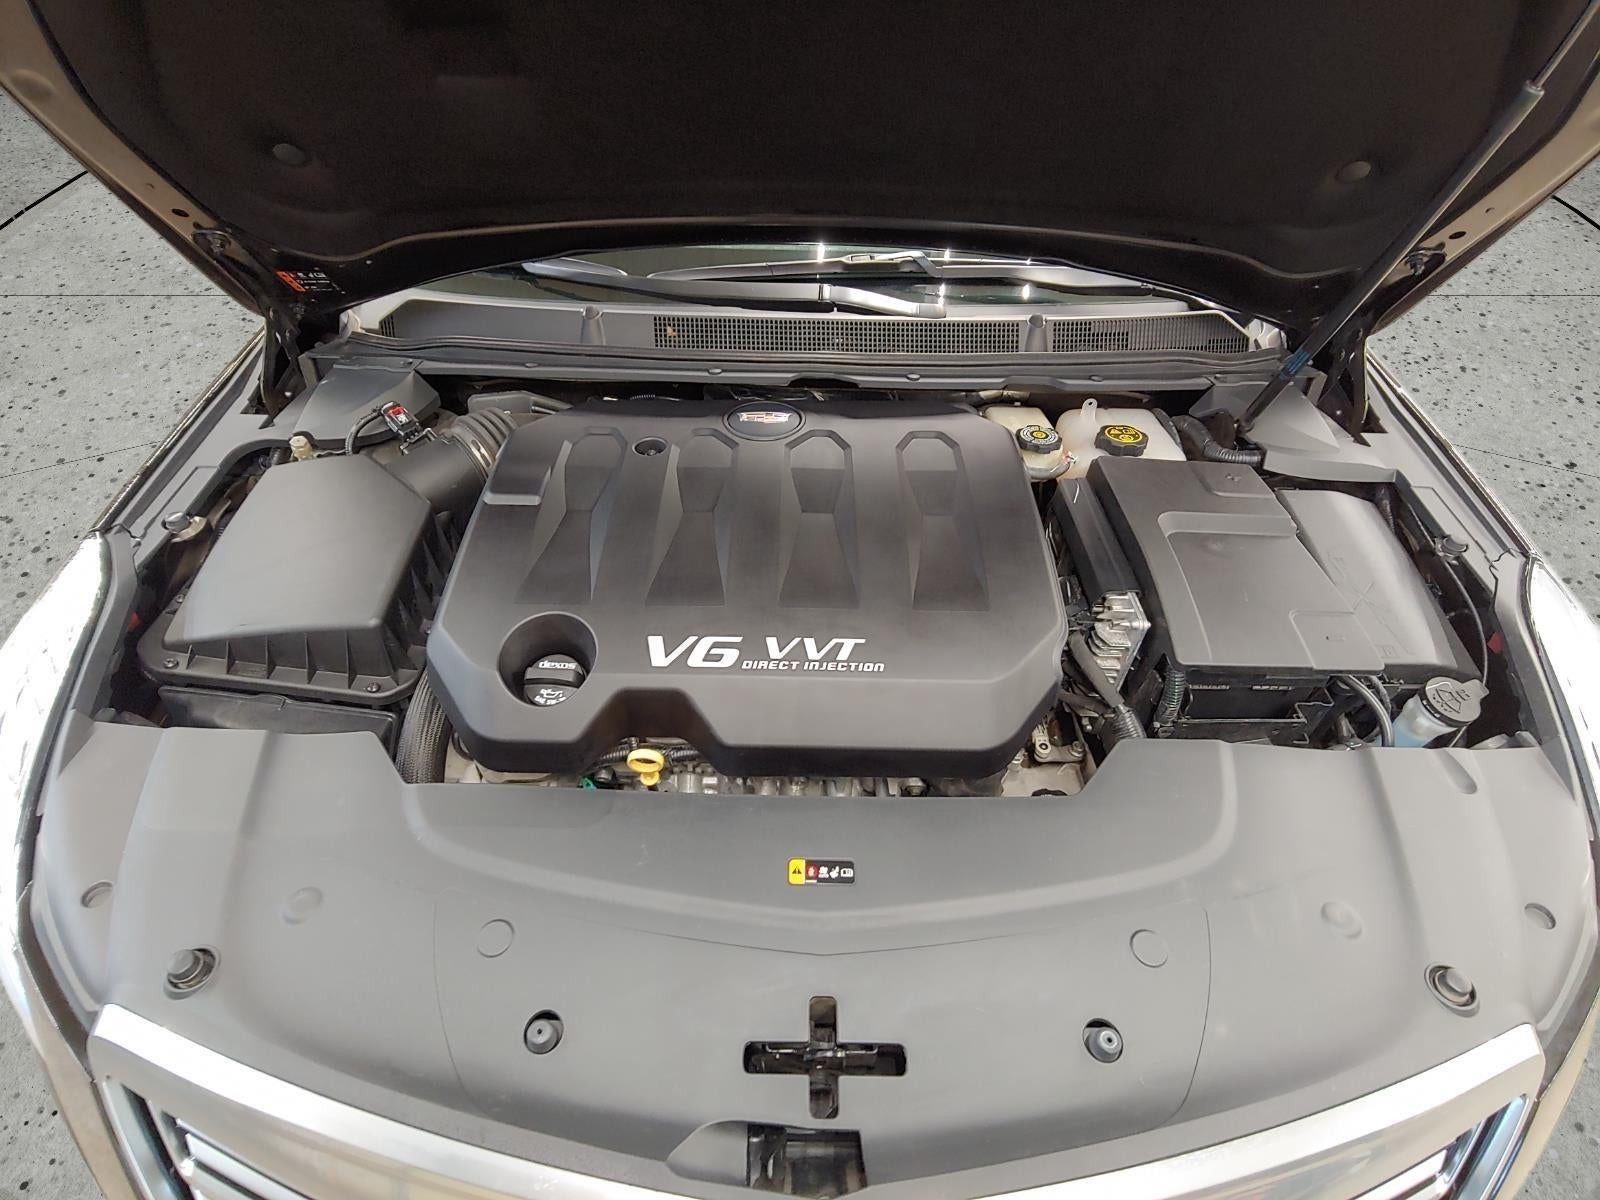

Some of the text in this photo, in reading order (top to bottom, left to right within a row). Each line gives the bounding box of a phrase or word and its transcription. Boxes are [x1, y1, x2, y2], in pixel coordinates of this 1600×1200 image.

[647, 635, 866, 668] V6 VVT
[538, 660, 578, 670] dexos
[741, 660, 885, 672] DIRECT INJECTION
